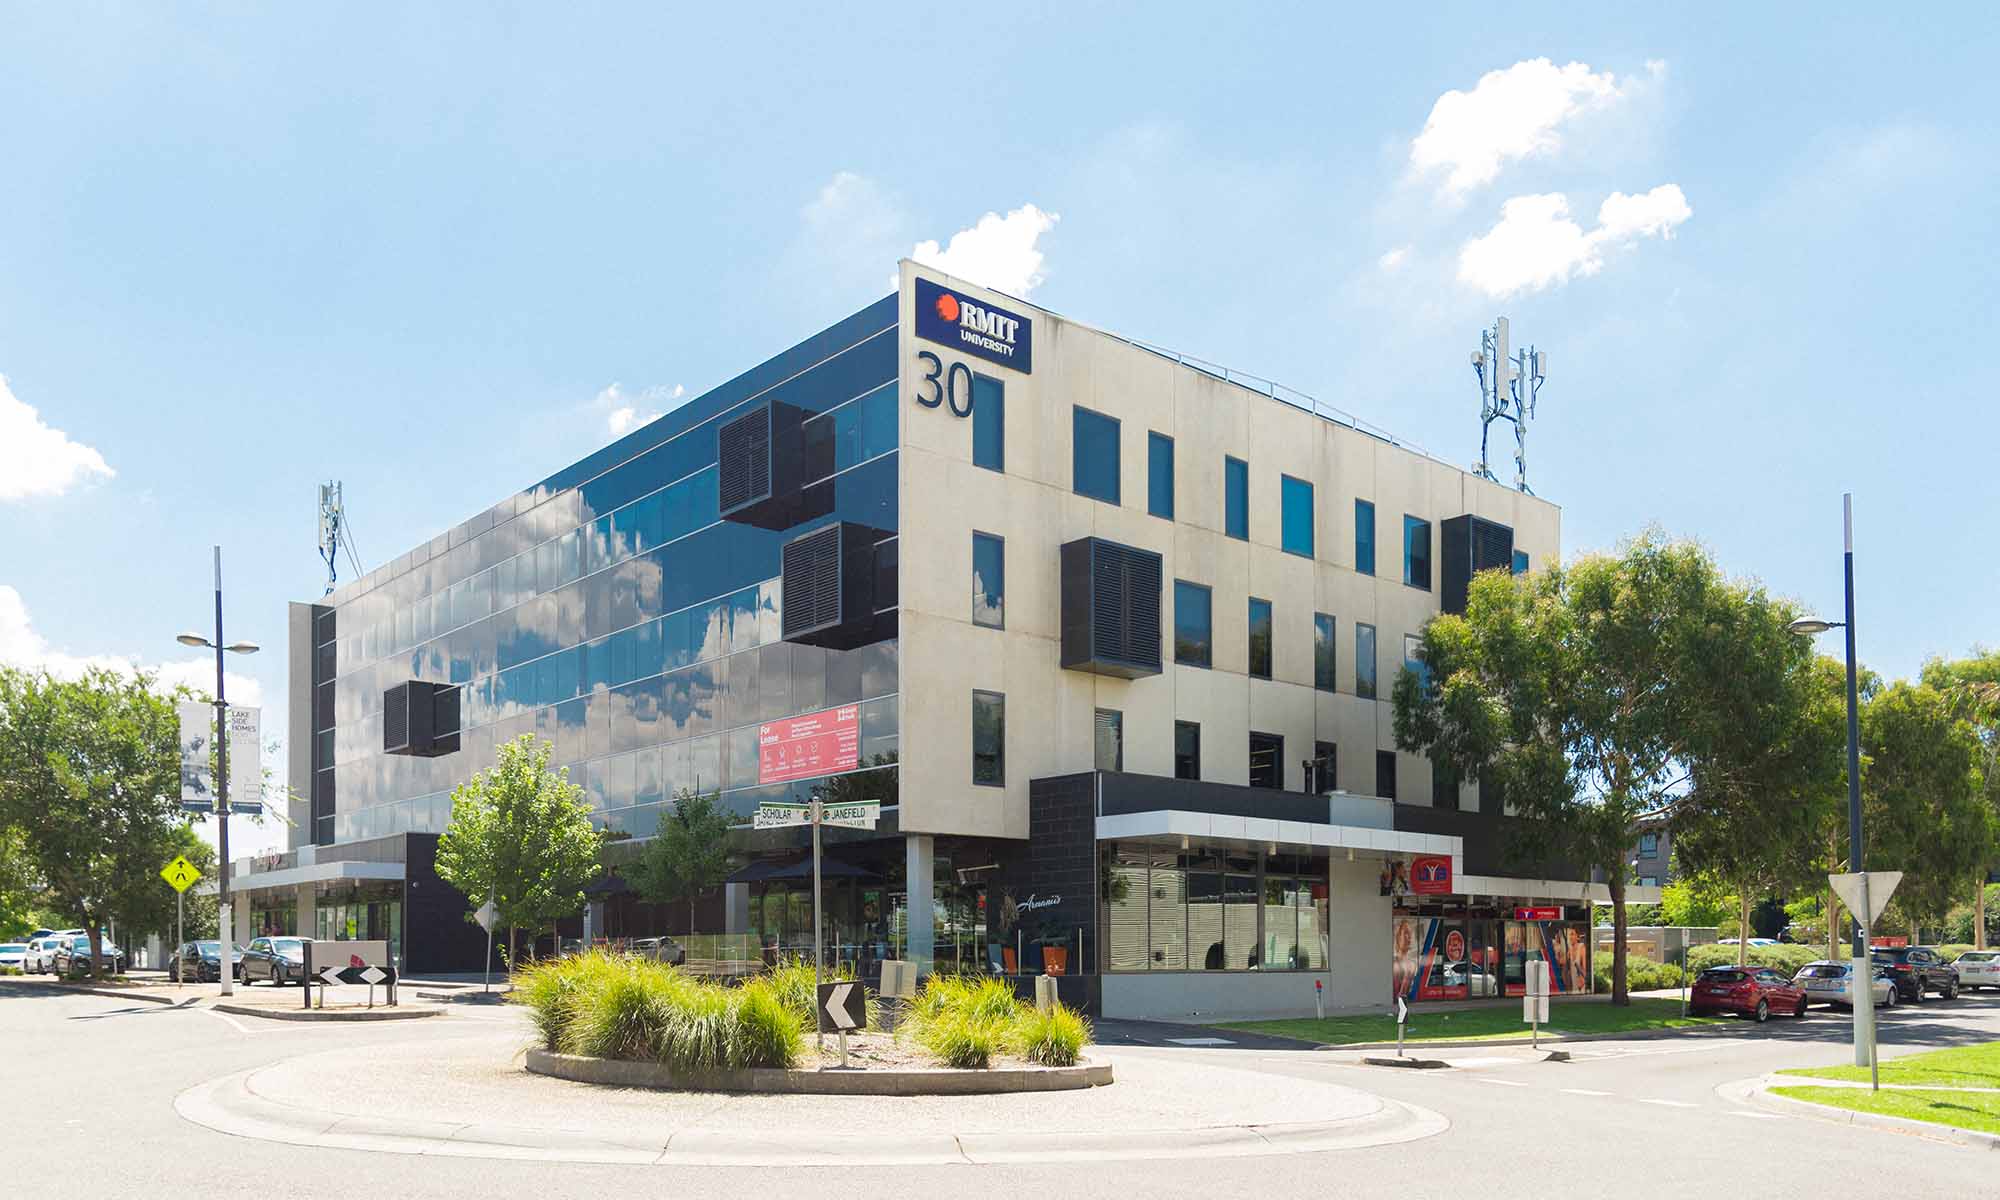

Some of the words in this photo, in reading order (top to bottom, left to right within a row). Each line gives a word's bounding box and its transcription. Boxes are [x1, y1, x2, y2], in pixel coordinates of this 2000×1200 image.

[959, 301, 1019, 344] RMIT
[960, 329, 1015, 357] UNIVERSITY
[917, 350, 974, 418] 30
[762, 808, 792, 820] SCHOLAR
[831, 807, 866, 820] JANEFIELD
